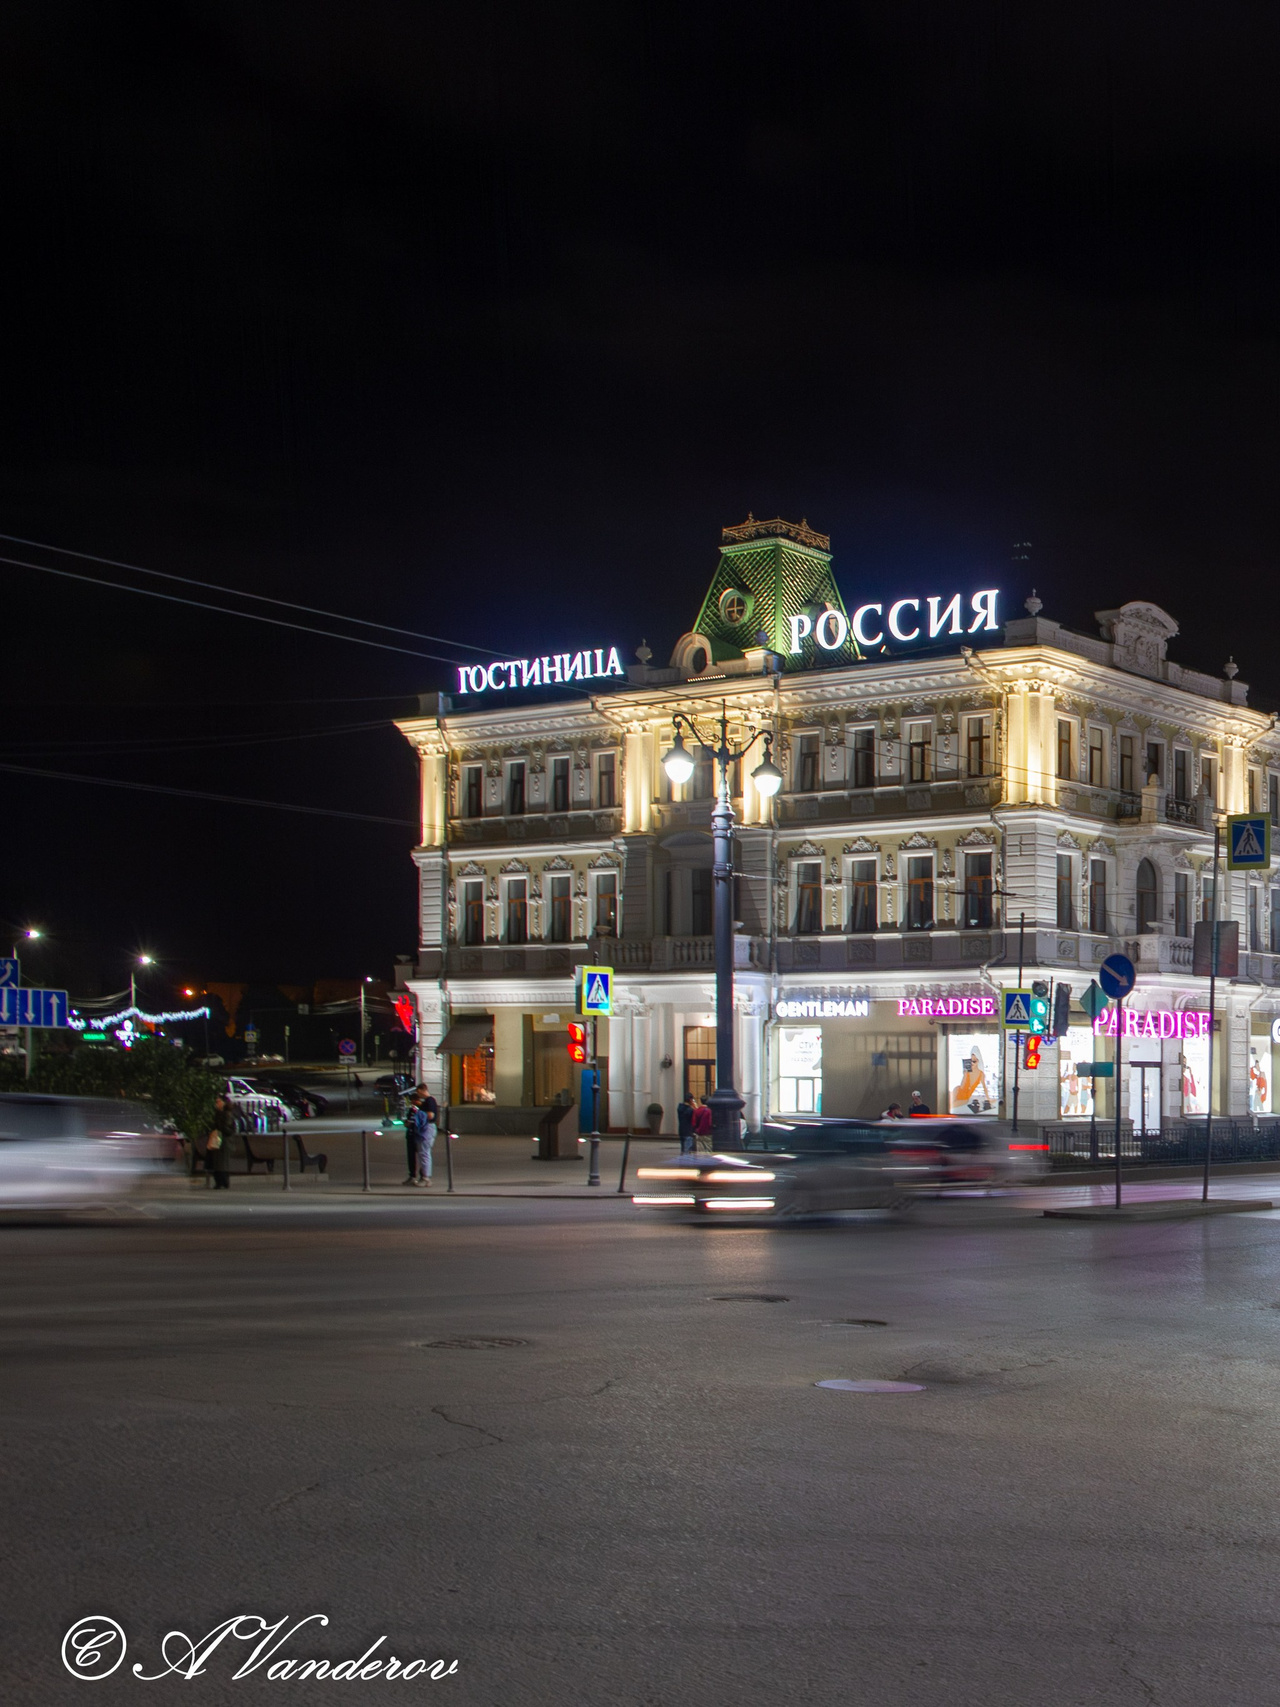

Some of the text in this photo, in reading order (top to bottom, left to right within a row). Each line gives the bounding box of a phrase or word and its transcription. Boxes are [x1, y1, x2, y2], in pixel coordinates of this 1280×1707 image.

[788, 589, 1000, 655] РОССИЯ
[457, 646, 625, 694] ГОСТИНИЦА
[775, 1001, 869, 1017] GENTLEMAN
[898, 998, 995, 1016] PARADISE
[1093, 1008, 1211, 1039] PARADISE
